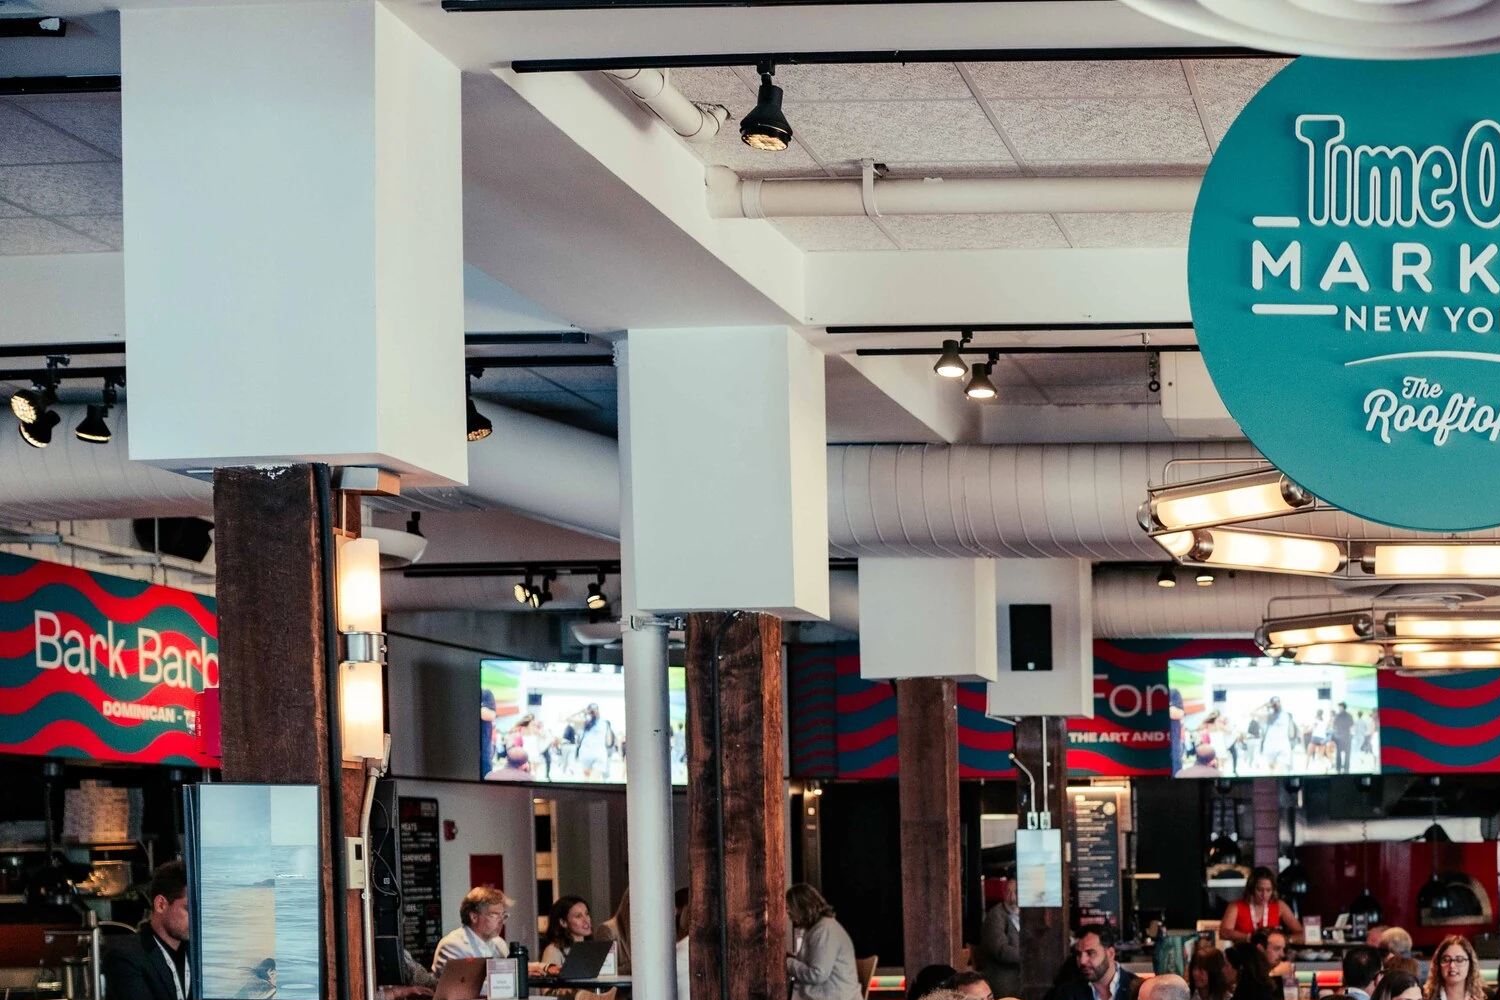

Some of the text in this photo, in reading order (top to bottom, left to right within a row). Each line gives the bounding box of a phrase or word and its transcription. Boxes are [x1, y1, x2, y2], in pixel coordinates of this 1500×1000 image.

[1295, 114, 1458, 228] Time
[1344, 304, 1430, 332] NEW
[1402, 376, 1443, 400] The
[34, 609, 128, 680] Bark
[102, 700, 176, 723] DOMINICAN
[1068, 731, 1165, 743] THE ART AND
